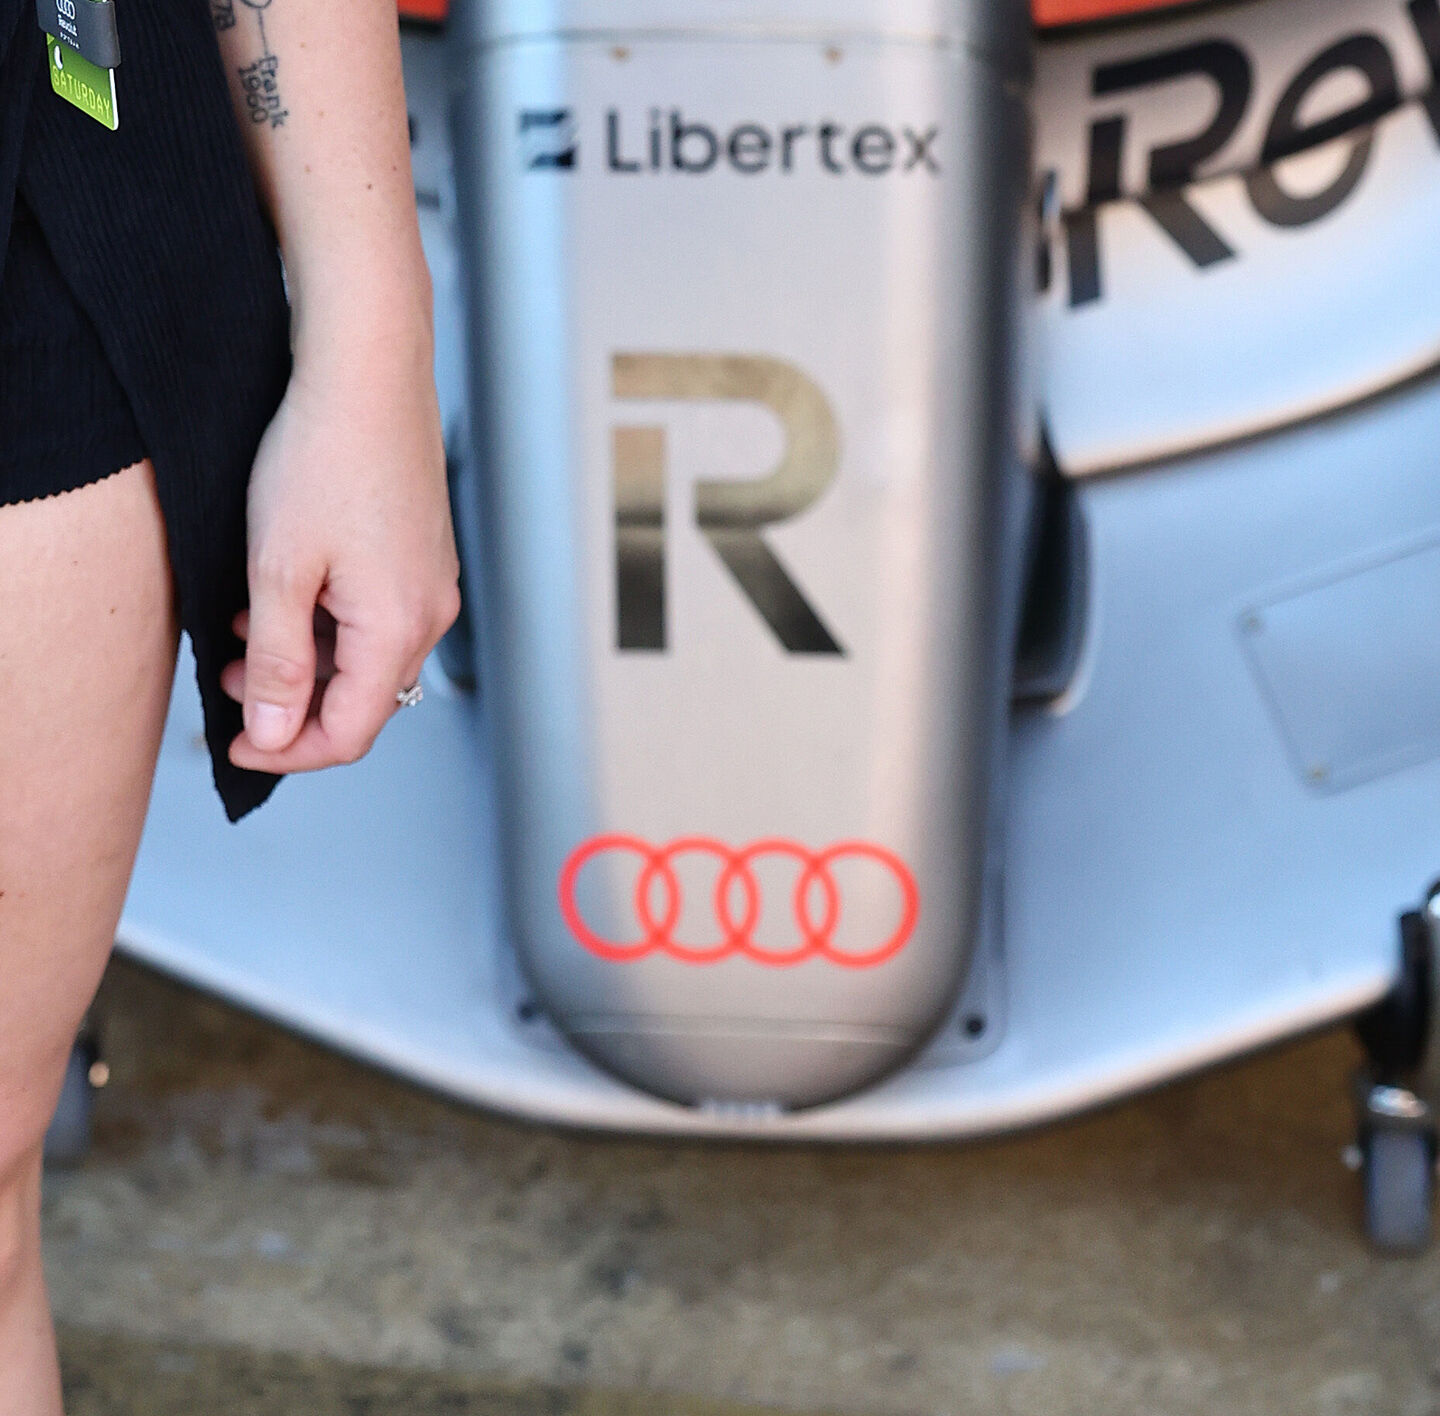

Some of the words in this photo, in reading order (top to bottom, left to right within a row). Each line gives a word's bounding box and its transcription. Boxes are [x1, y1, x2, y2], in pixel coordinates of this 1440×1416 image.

[52, 65, 111, 121] SATURDAY
[259, 54, 290, 131] Frank
[606, 108, 941, 176] Libertex
